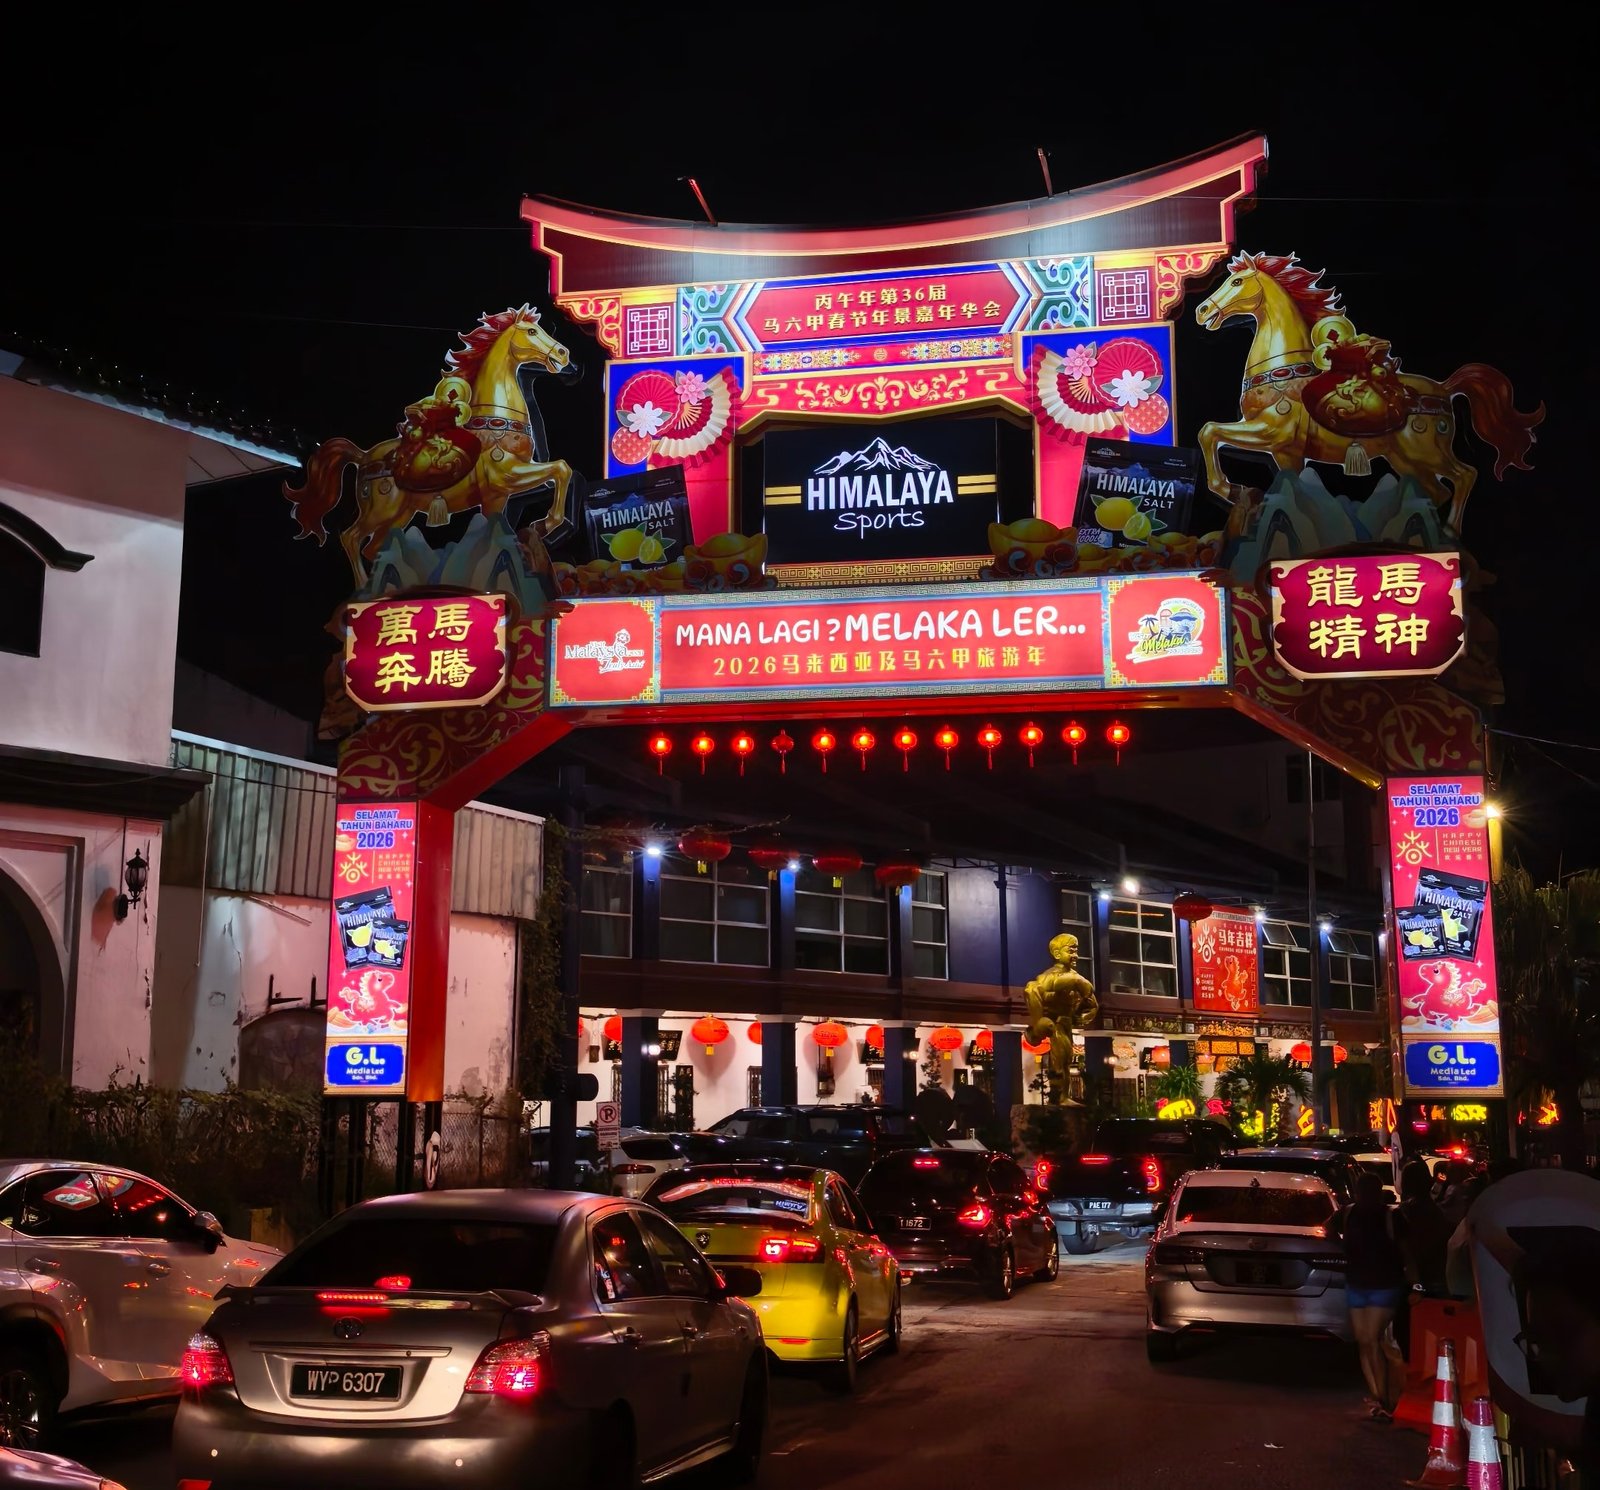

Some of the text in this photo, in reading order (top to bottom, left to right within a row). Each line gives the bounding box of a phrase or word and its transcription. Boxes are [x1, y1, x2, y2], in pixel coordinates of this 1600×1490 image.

[815, 284, 947, 311] 丙午年第36届
[763, 300, 1001, 334] 马六甲春节年景嘉年华会
[807, 470, 954, 511] HIMALAYA
[1096, 473, 1175, 499] HIMALAYA
[1143, 498, 1174, 509] SALT
[602, 500, 675, 529] HIMALAYA
[648, 517, 676, 530] SALT
[833, 508, 925, 540] Sports
[1306, 562, 1427, 608] 龍馬
[375, 603, 474, 647] 萬馬
[675, 621, 751, 647] MANA
[992, 605, 1086, 637] LER...
[1308, 612, 1430, 660] 精神
[712, 645, 1047, 676] 2026马来西亚及马六甲旅游年
[374, 648, 477, 694] 奔騰
[1409, 784, 1462, 795] SELAMAT
[1392, 795, 1480, 807] TAHUN BAHARU
[355, 810, 399, 820] SELAMAT
[1415, 808, 1460, 826] 2026
[340, 820, 413, 831] TAHUN BAHARU
[357, 832, 394, 848] 2026
[1425, 892, 1473, 912] HIMALAYA
[347, 908, 388, 928] HIMALAYA
[1453, 910, 1473, 919] SALT
[345, 1046, 386, 1065] G.L.
[1427, 1044, 1477, 1065] G.L.
[346, 1067, 385, 1075] Media Led
[1430, 1067, 1477, 1075] Media Led
[342, 1372, 386, 1394] 6307
